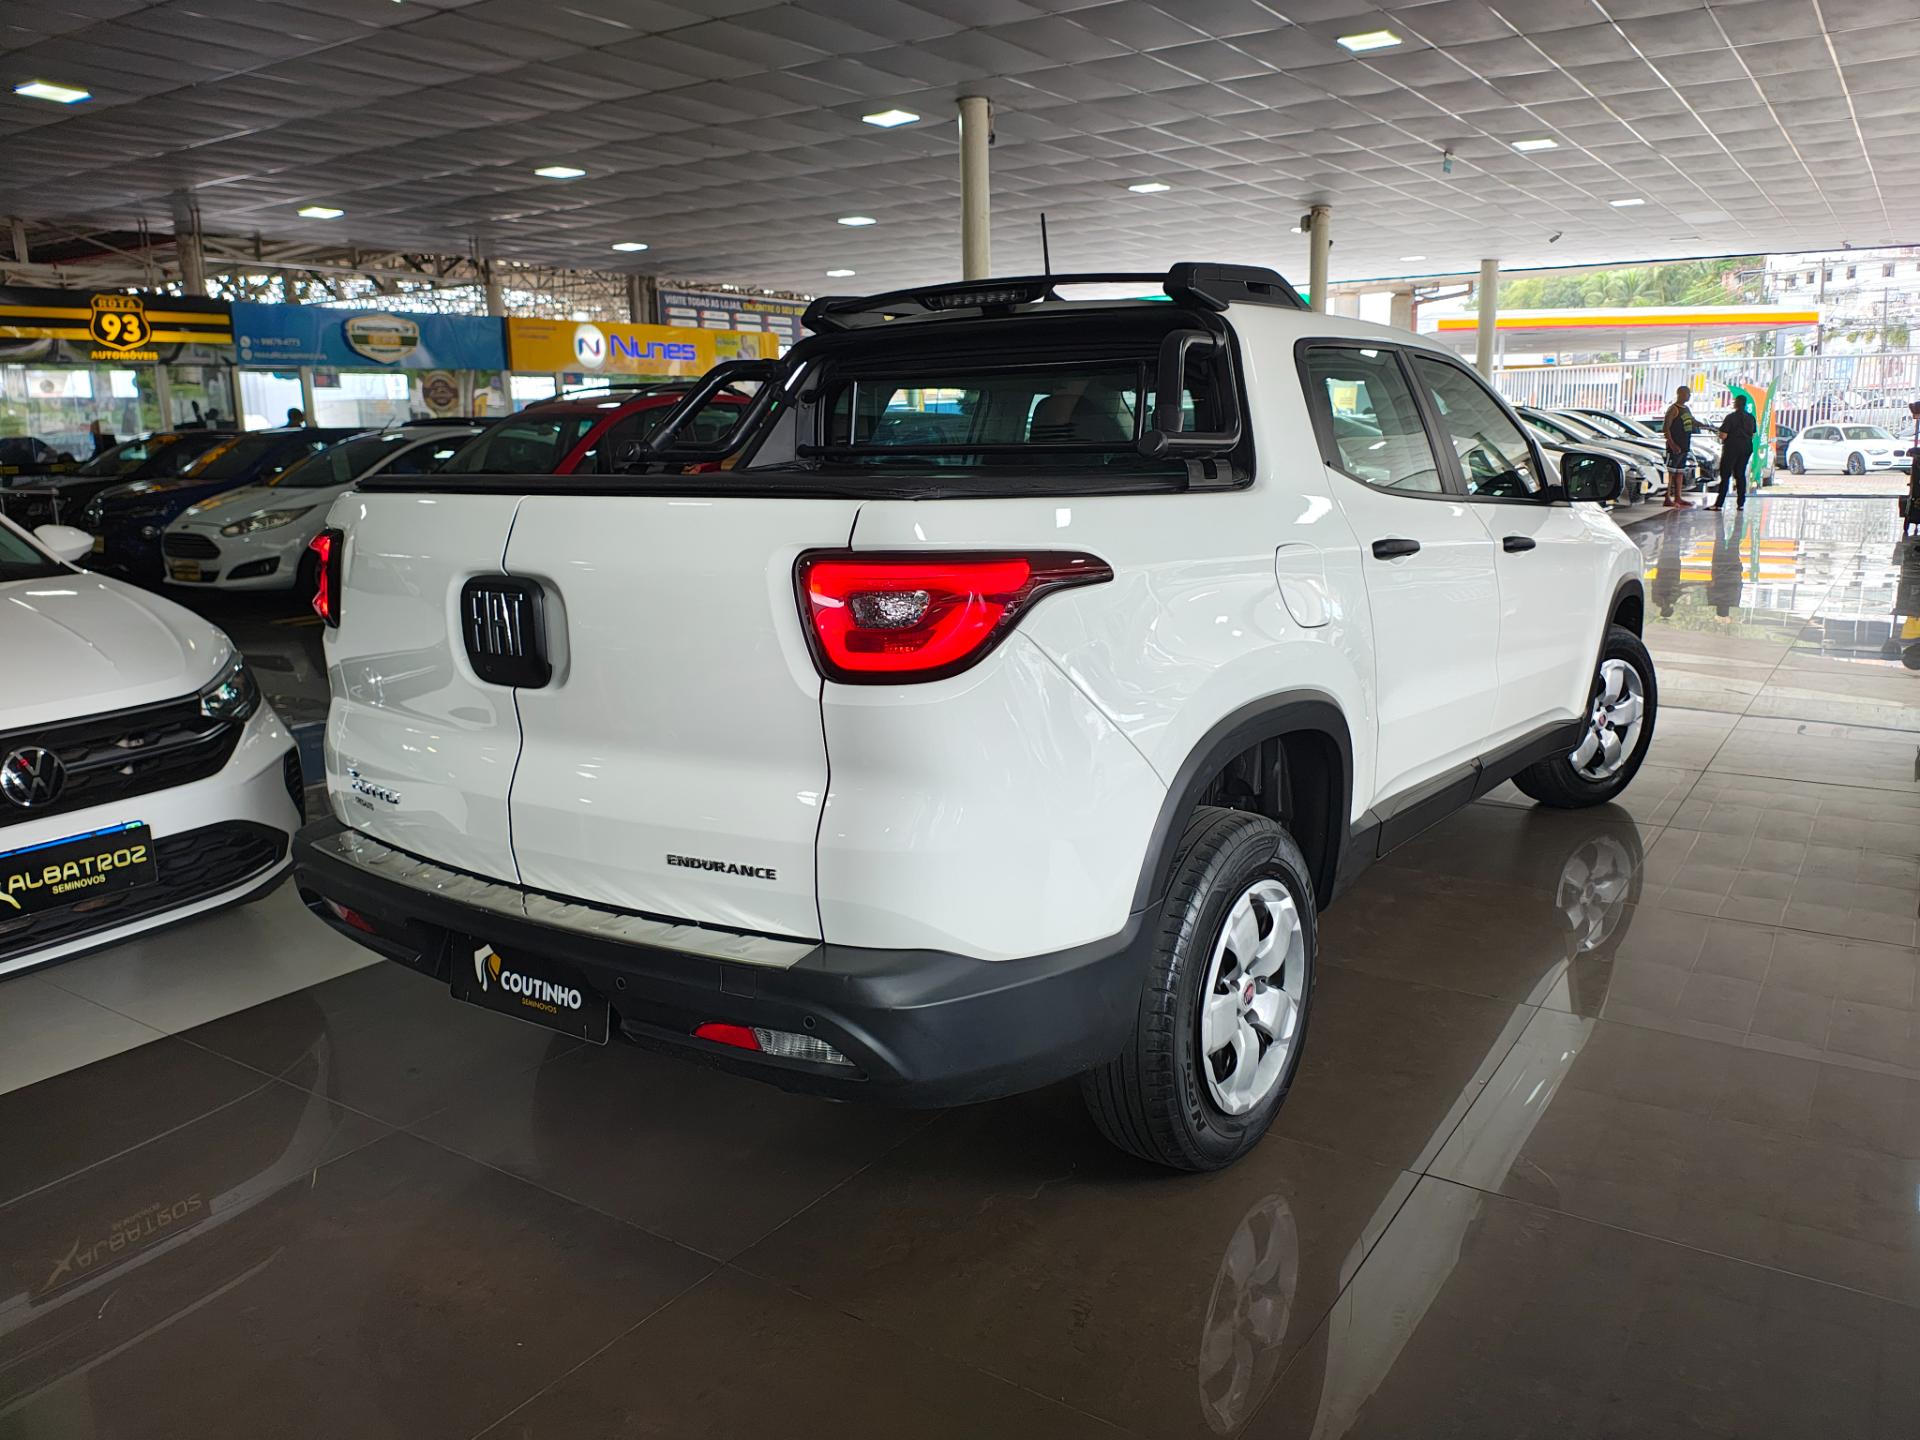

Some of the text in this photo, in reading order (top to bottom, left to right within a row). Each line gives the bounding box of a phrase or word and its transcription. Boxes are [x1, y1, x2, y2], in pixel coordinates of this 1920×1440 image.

[98, 298, 136, 308] ROTA
[101, 313, 142, 342] 93
[91, 350, 159, 361] AUTOMÓVEIS
[610, 334, 696, 361] Nunes
[8, 845, 148, 894] ALBATROZ
[666, 854, 777, 880] ENDURANCE
[52, 873, 106, 895] SEMINOVOS
[501, 970, 582, 1010] COUTINHO
[521, 997, 558, 1015] SEMINOVOS
